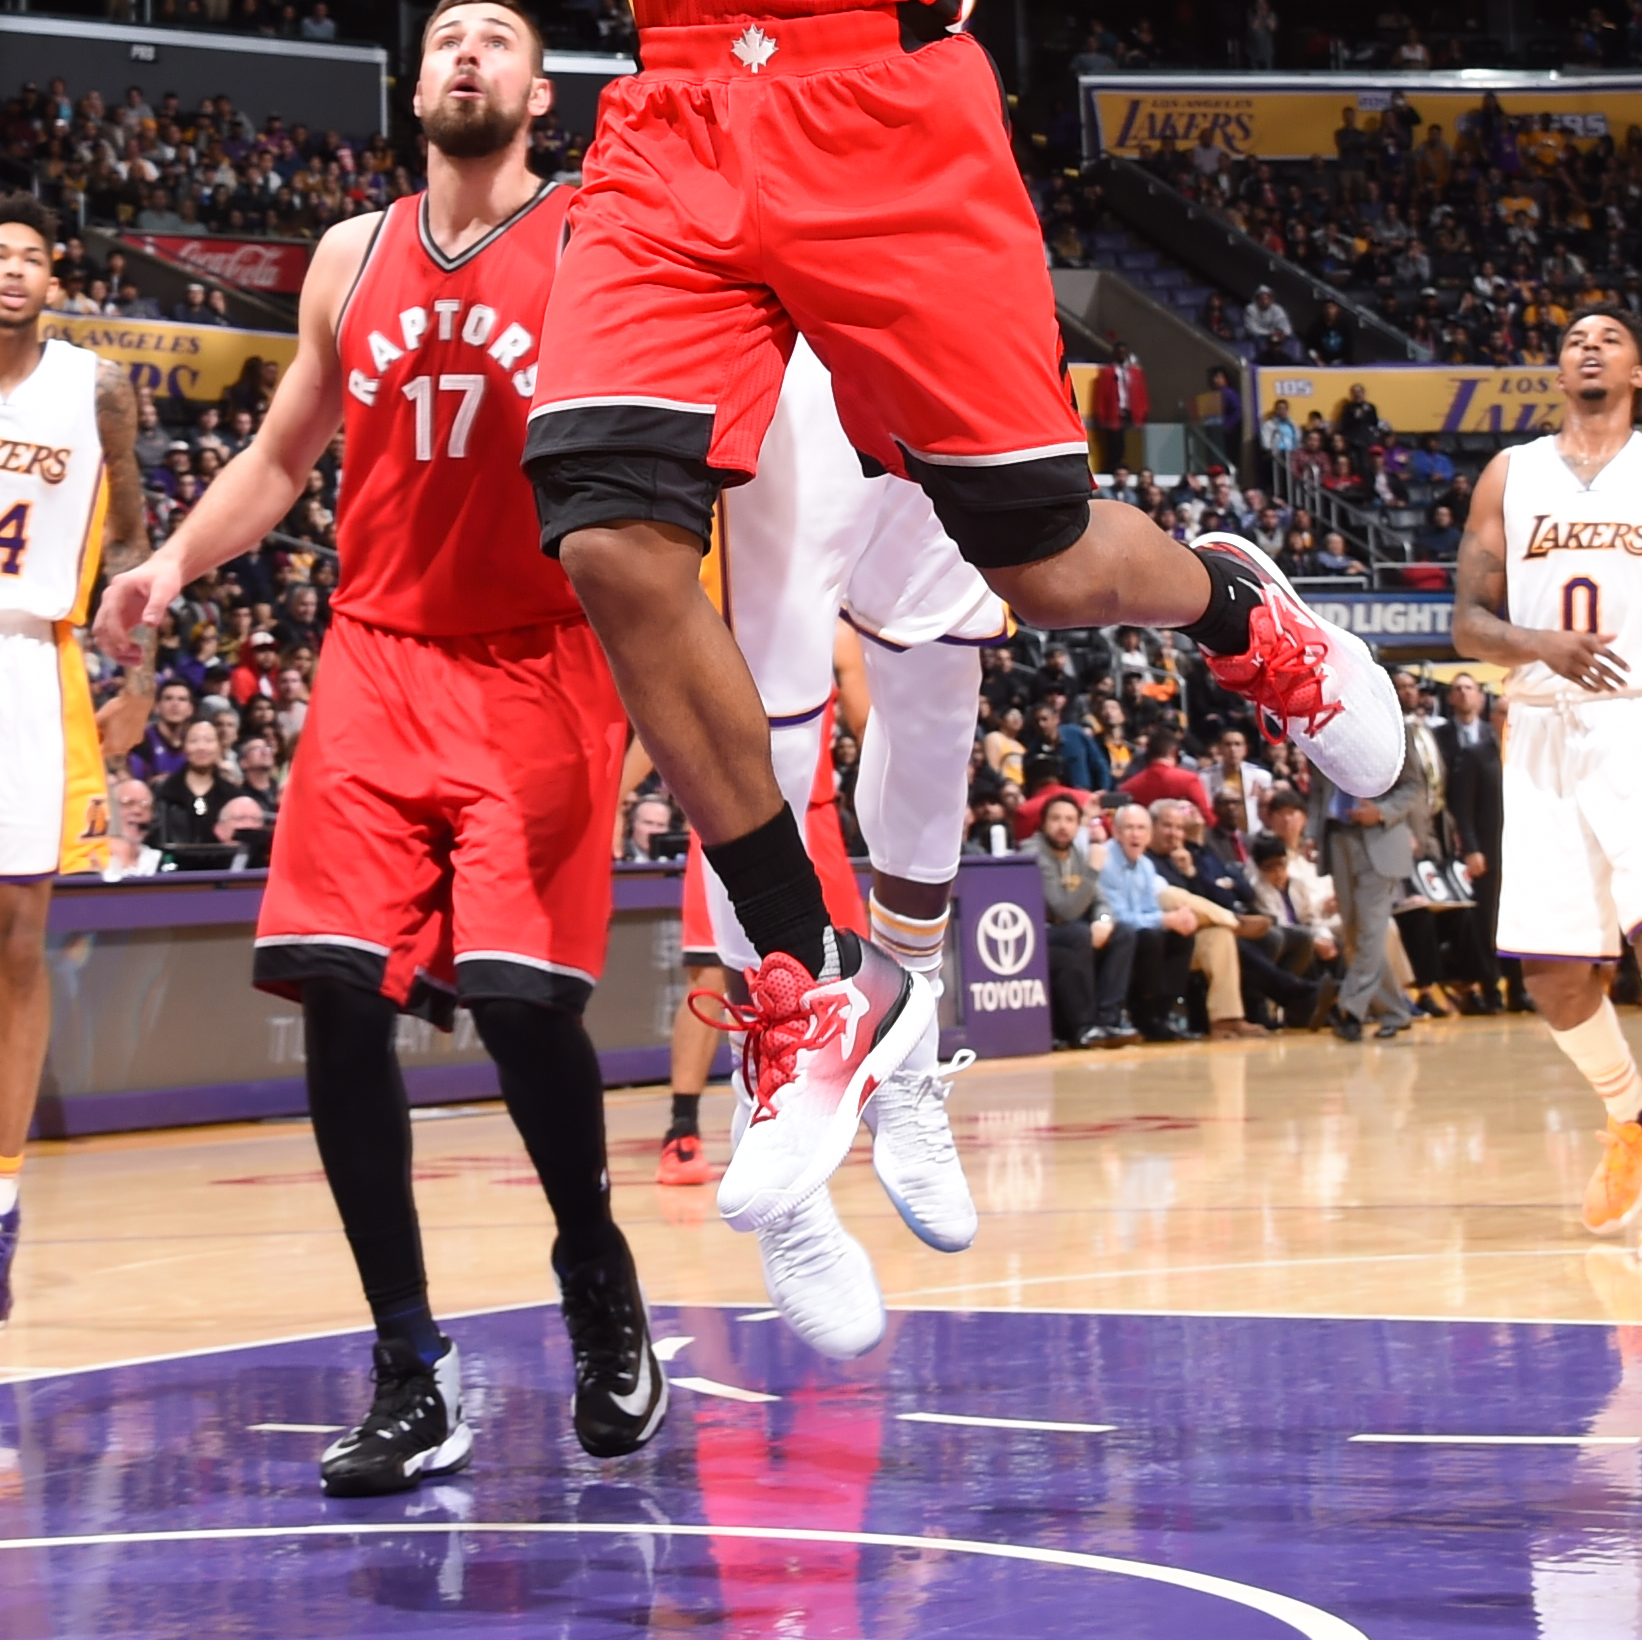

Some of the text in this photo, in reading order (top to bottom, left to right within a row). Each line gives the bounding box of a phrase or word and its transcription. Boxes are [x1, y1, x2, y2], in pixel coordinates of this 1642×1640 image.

[1115, 99, 1254, 154] LAKERS
[179, 240, 284, 288] Coca-Cola
[42, 324, 201, 355] OS ANGELES
[1274, 379, 1313, 397] 105
[1499, 376, 1551, 395] LOS
[401, 373, 486, 461] 17
[1352, 603, 1455, 634] LIGHT
[1561, 574, 1603, 635] 0
[969, 978, 1047, 1012] TOYOTA
